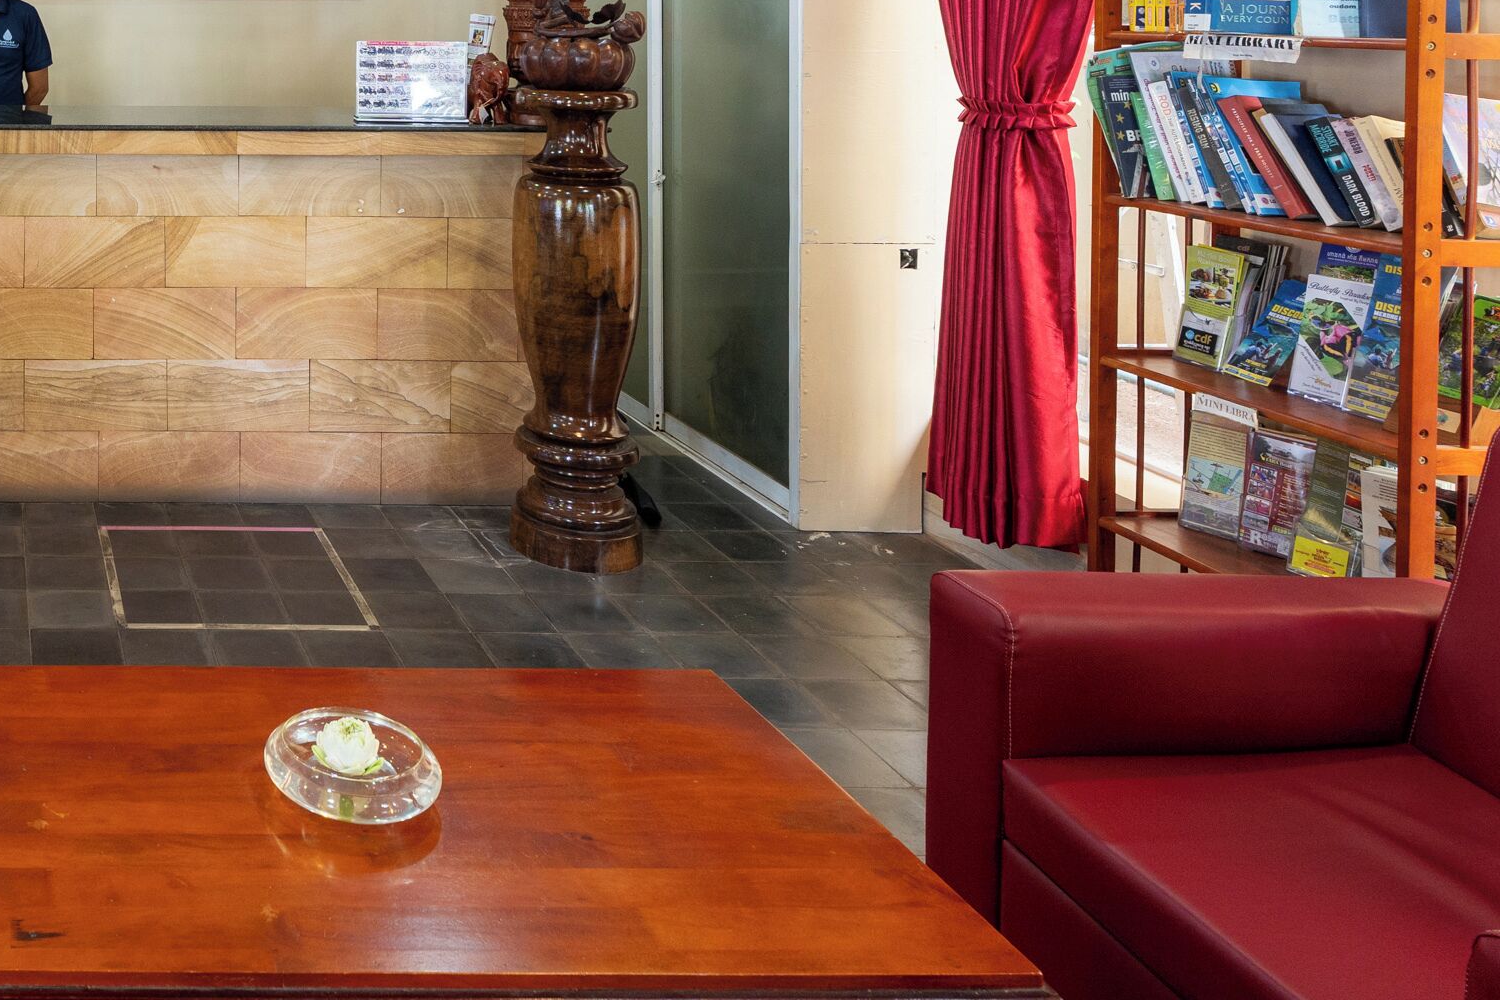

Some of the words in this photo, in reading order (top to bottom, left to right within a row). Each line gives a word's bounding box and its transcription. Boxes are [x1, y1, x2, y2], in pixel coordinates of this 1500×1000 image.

[1220, 14, 1253, 23] EVERY
[1223, 4, 1234, 14] A
[1186, 35, 1221, 46] MINI
[1225, 36, 1294, 50] LIBRARY
[1157, 93, 1171, 116] ROD
[1187, 108, 1204, 133] RISING
[1199, 133, 1211, 149] SUN
[1321, 125, 1340, 147] STUART
[1308, 124, 1333, 153] MACBRIDE
[1341, 174, 1357, 196] DARK
[1351, 194, 1370, 217] BLOOD
[1194, 332, 1213, 345] cdf
[1197, 395, 1225, 412] MINI
